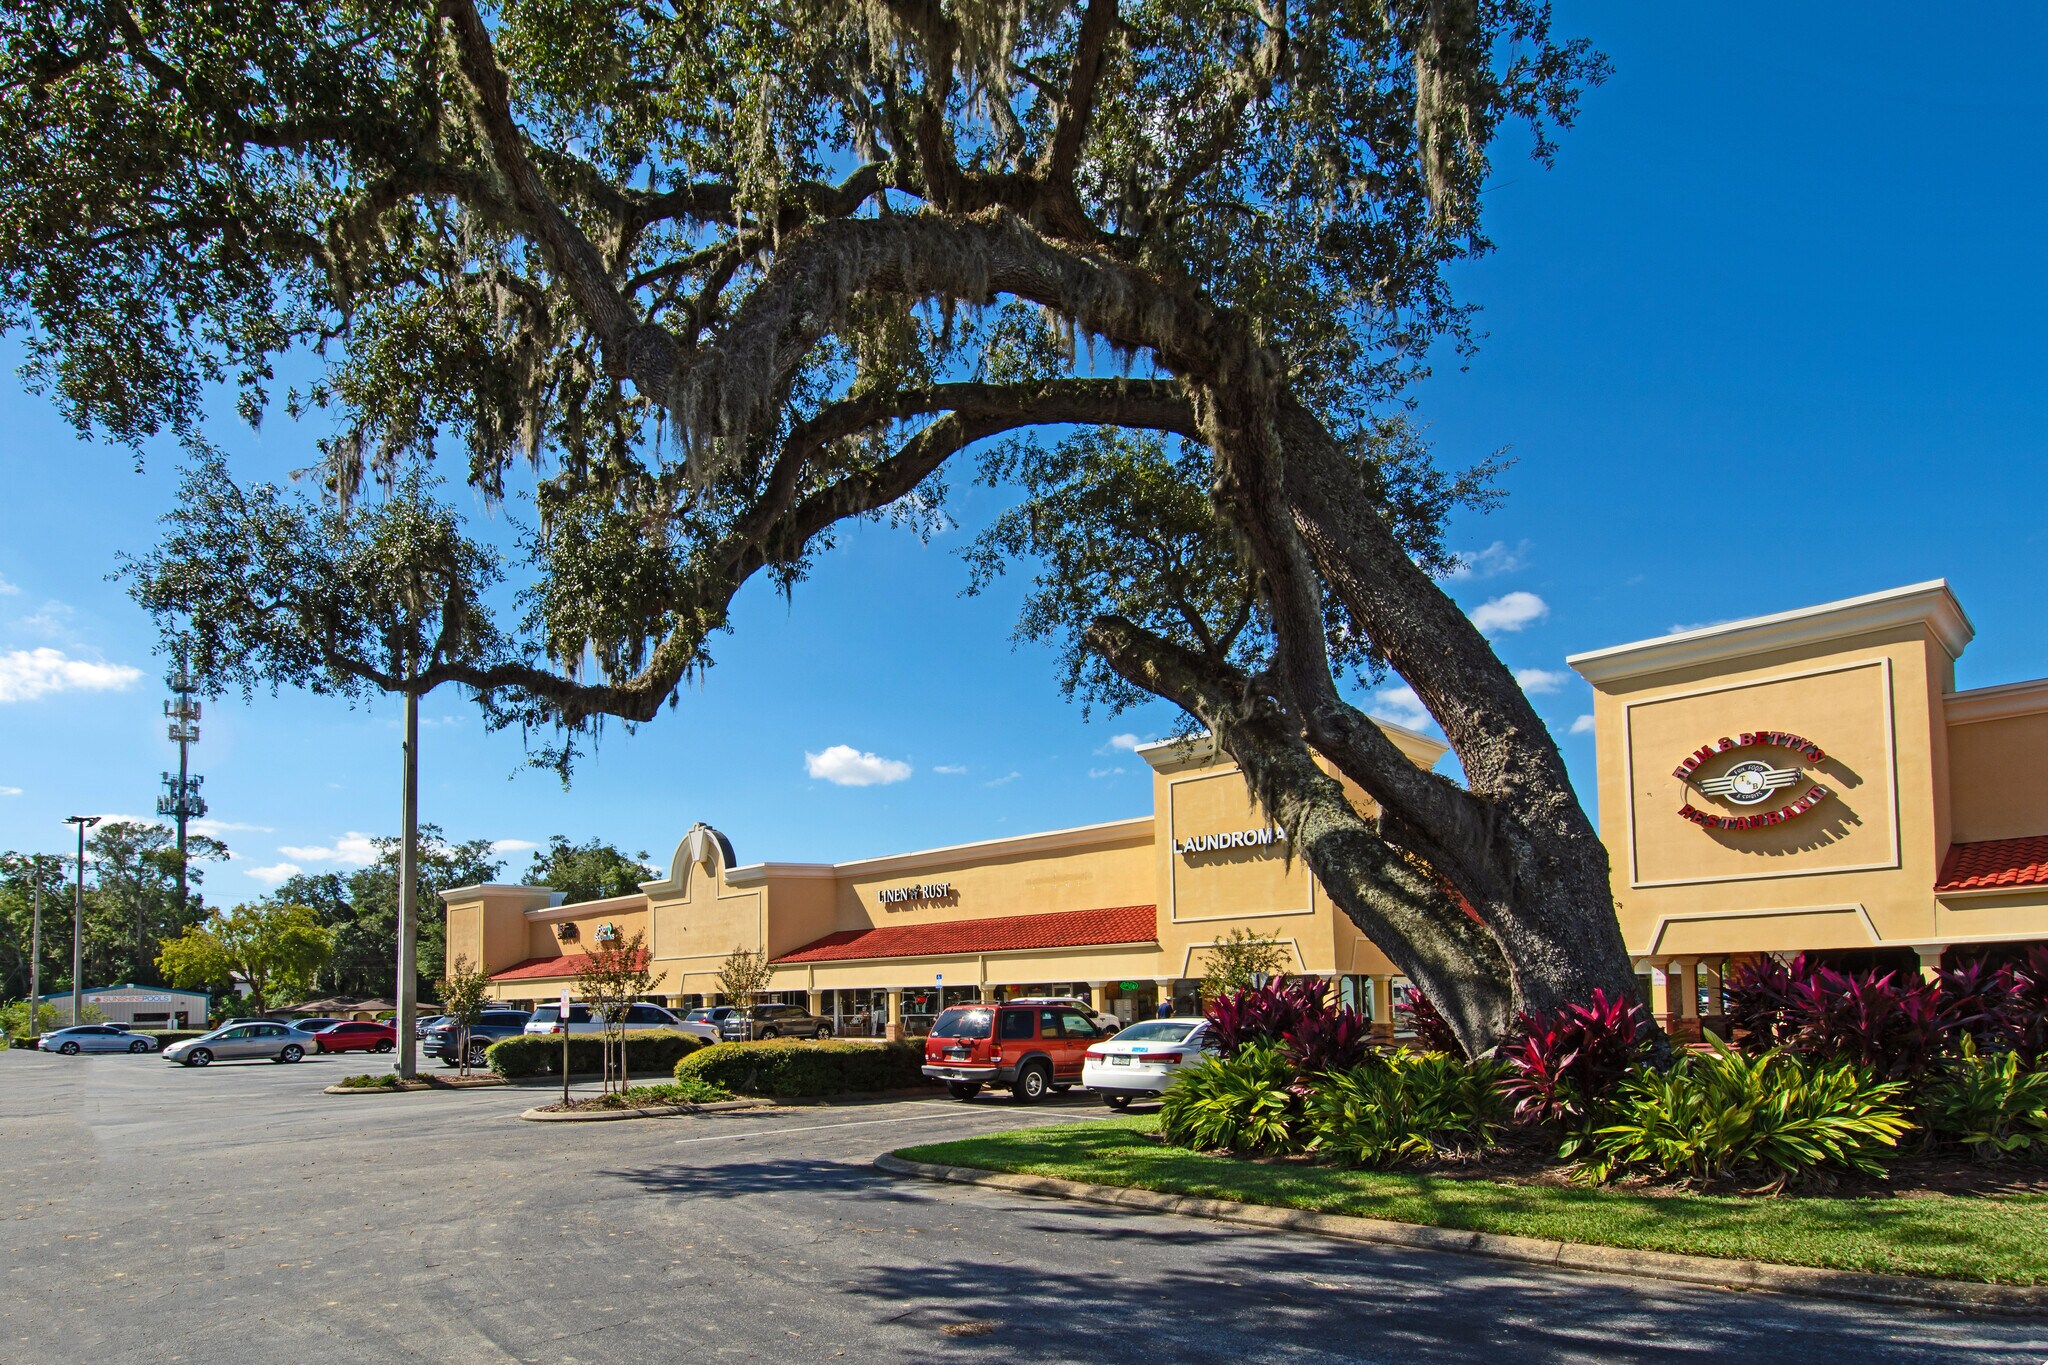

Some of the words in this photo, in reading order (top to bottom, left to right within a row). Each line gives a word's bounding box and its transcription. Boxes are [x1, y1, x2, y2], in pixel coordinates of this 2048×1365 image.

[1672, 745, 1716, 780] TOM
[1718, 737, 1733, 751] &
[1739, 731, 1826, 762] BETTY'S
[1677, 785, 1827, 831] RESTAURANT
[1173, 826, 1287, 854] LAUNDROMA
[878, 888, 908, 903] LINEN
[922, 883, 950, 899] RUST
[1121, 982, 1137, 990] OPEN
